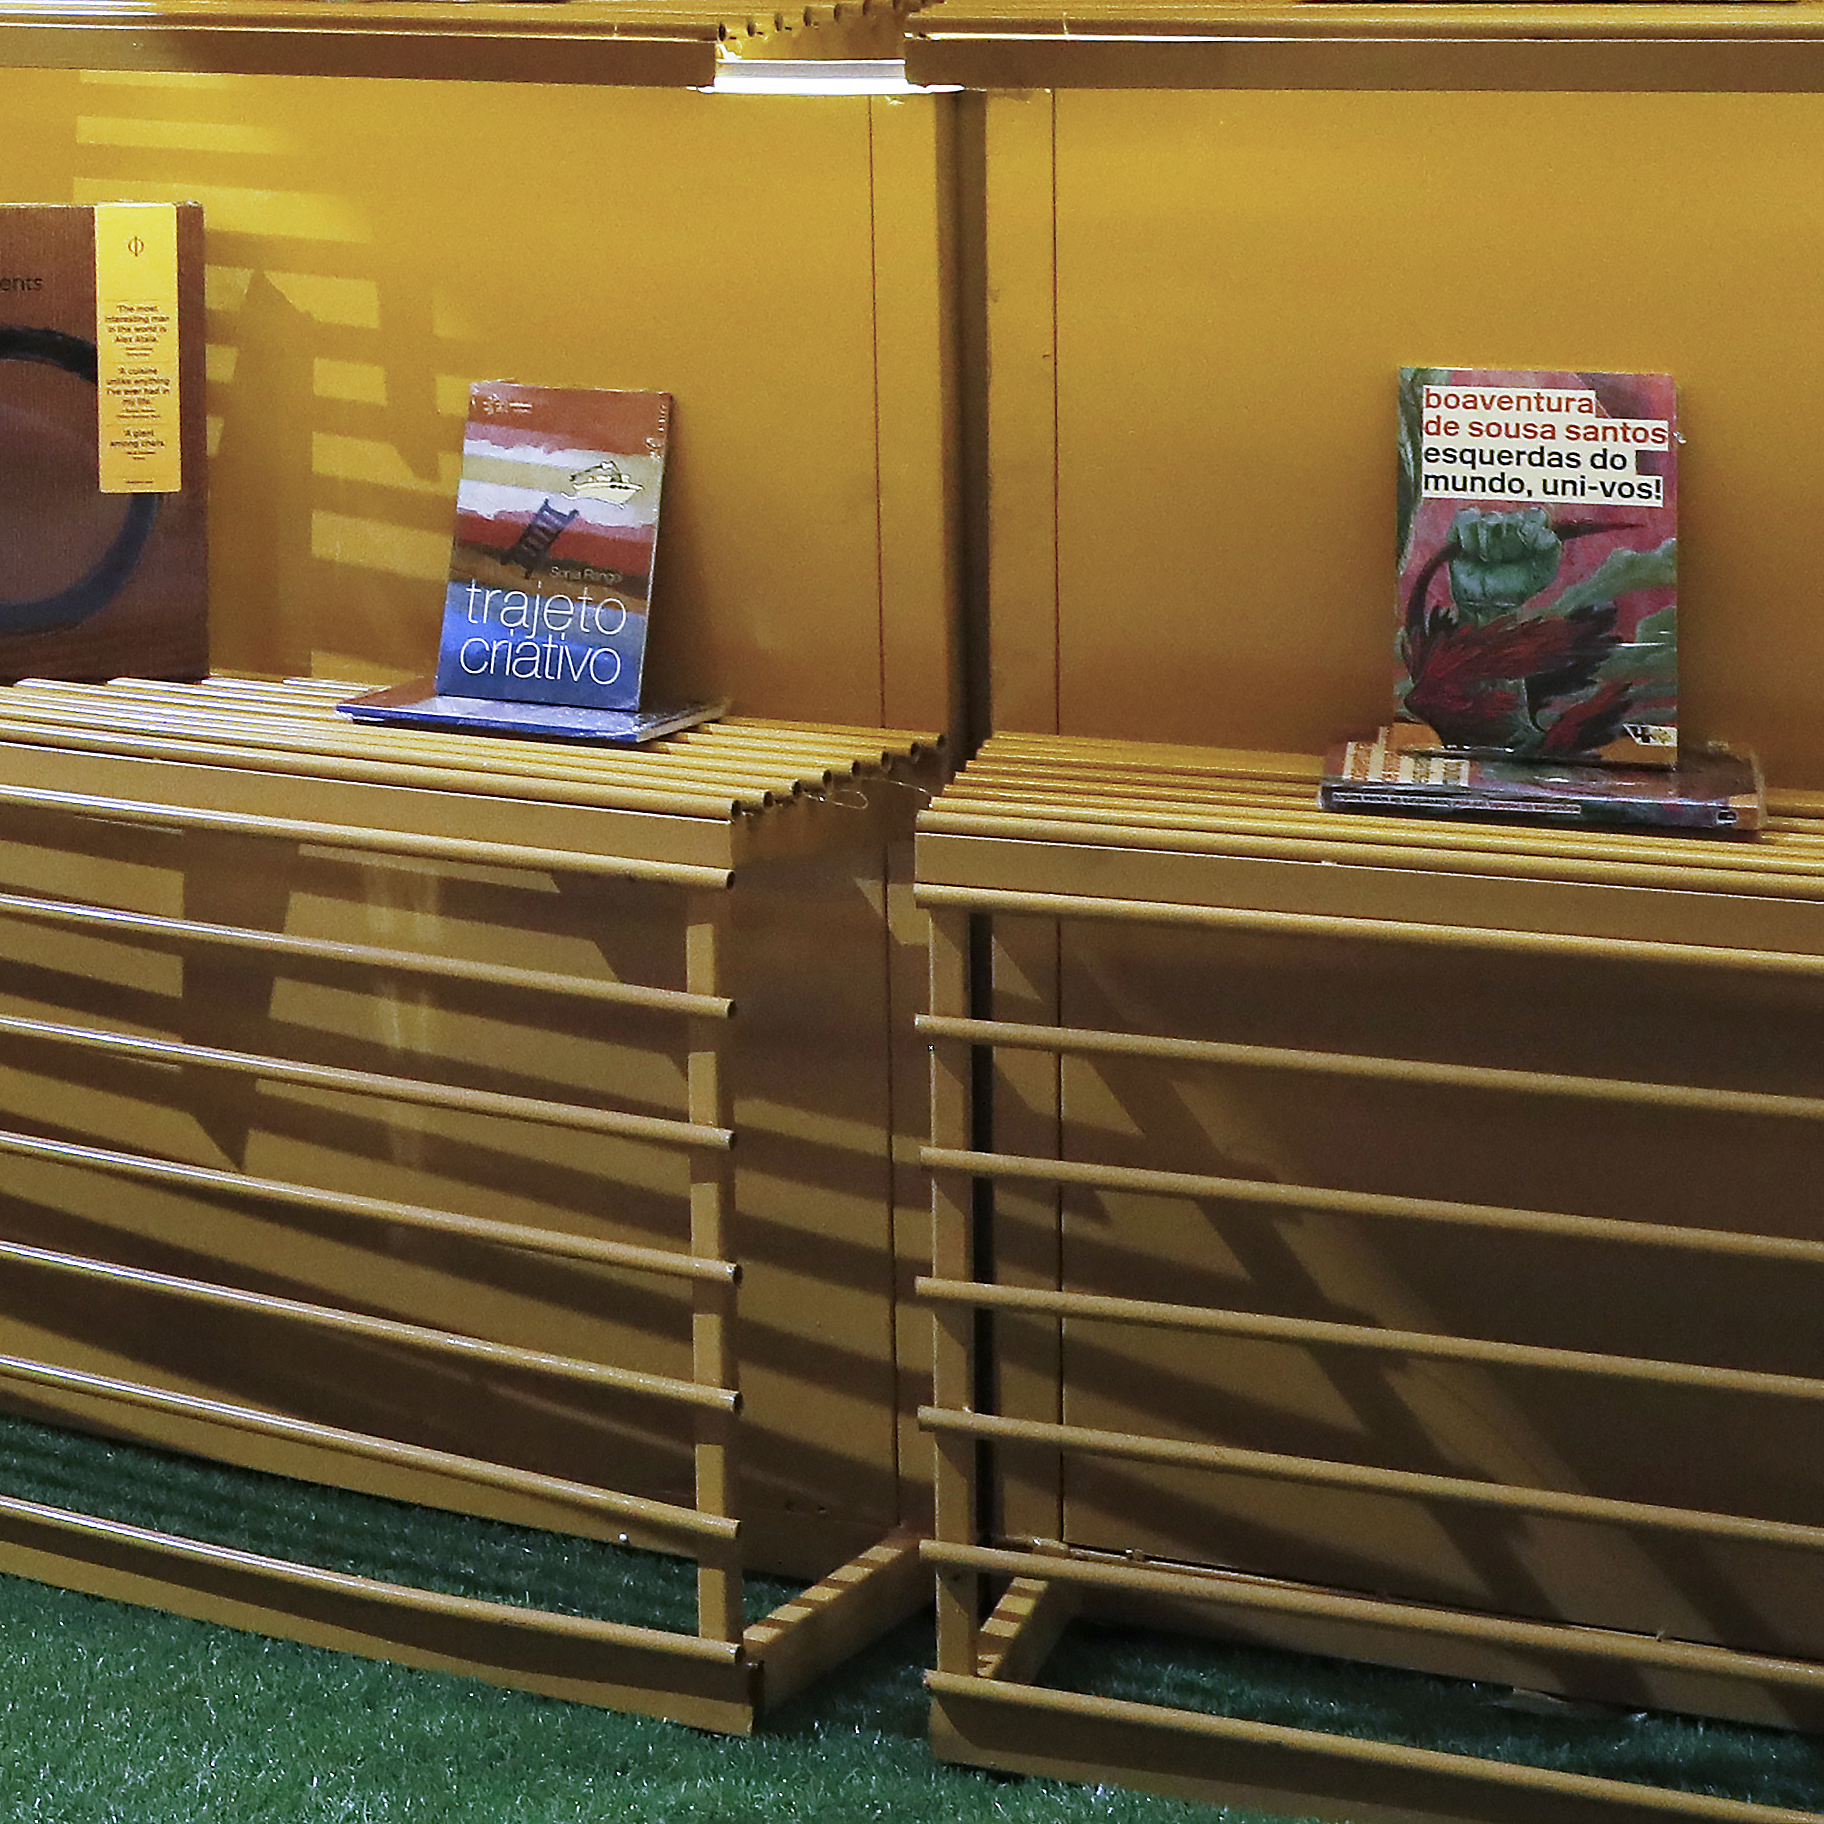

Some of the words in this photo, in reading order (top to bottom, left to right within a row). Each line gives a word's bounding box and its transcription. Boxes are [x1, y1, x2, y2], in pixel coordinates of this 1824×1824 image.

[1425, 388, 1593, 415] boaventura
[1425, 415, 1459, 437] de
[1468, 420, 1556, 441] sousa
[1565, 421, 1668, 444] santos
[1424, 445, 1581, 471] esquerdas
[1590, 447, 1627, 471] do
[1424, 472, 1532, 498] mundo,
[1543, 475, 1661, 501] uni-vos!
[466, 578, 627, 639] trajeto
[460, 629, 621, 685] criativo
